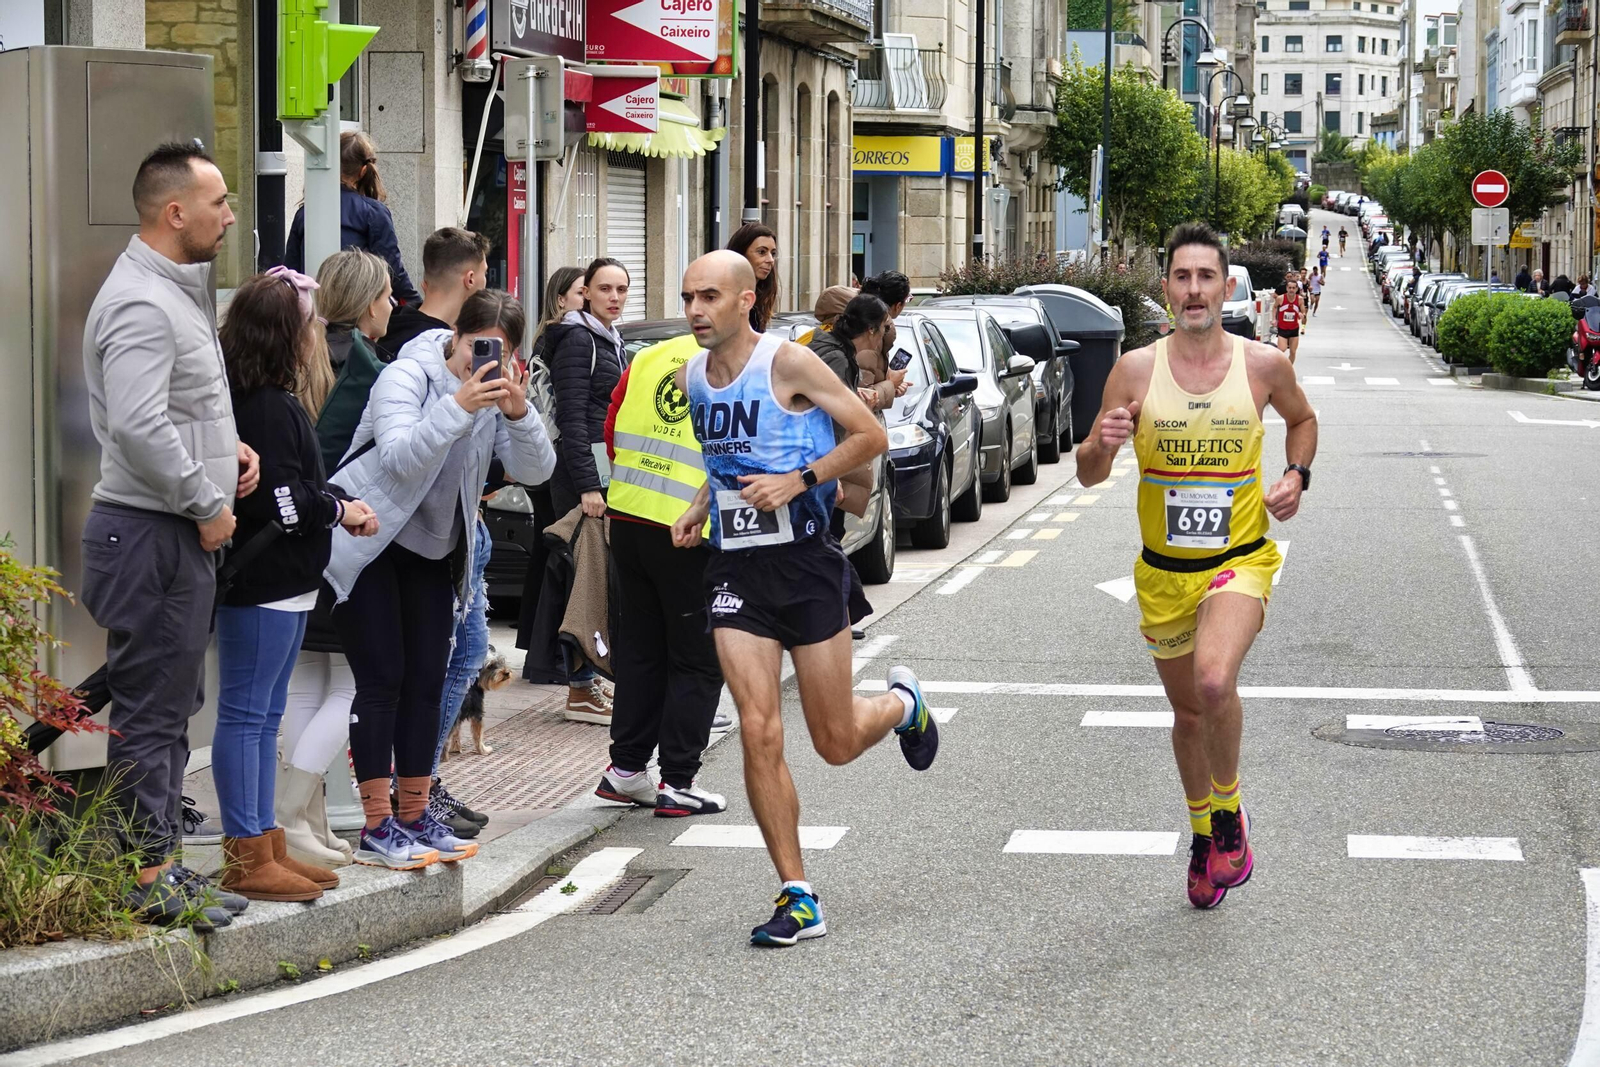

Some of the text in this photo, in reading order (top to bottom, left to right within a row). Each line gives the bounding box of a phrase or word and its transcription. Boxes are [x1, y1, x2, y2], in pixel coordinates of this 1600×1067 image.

[660, 0, 713, 15] Cajero
[660, 25, 710, 38] Caixeiro
[625, 94, 655, 105] Cajero
[625, 111, 654, 119] Caixeiro
[853, 147, 910, 165] ORREOS
[693, 399, 761, 441] ADN
[1210, 417, 1249, 426] San Lázaro
[1156, 438, 1243, 454] ATHLETICS
[1166, 453, 1229, 467] San Lázaro
[273, 486, 299, 525] GANG
[733, 507, 760, 531] 62
[1178, 508, 1223, 532] 699
[711, 594, 744, 609] ADN
